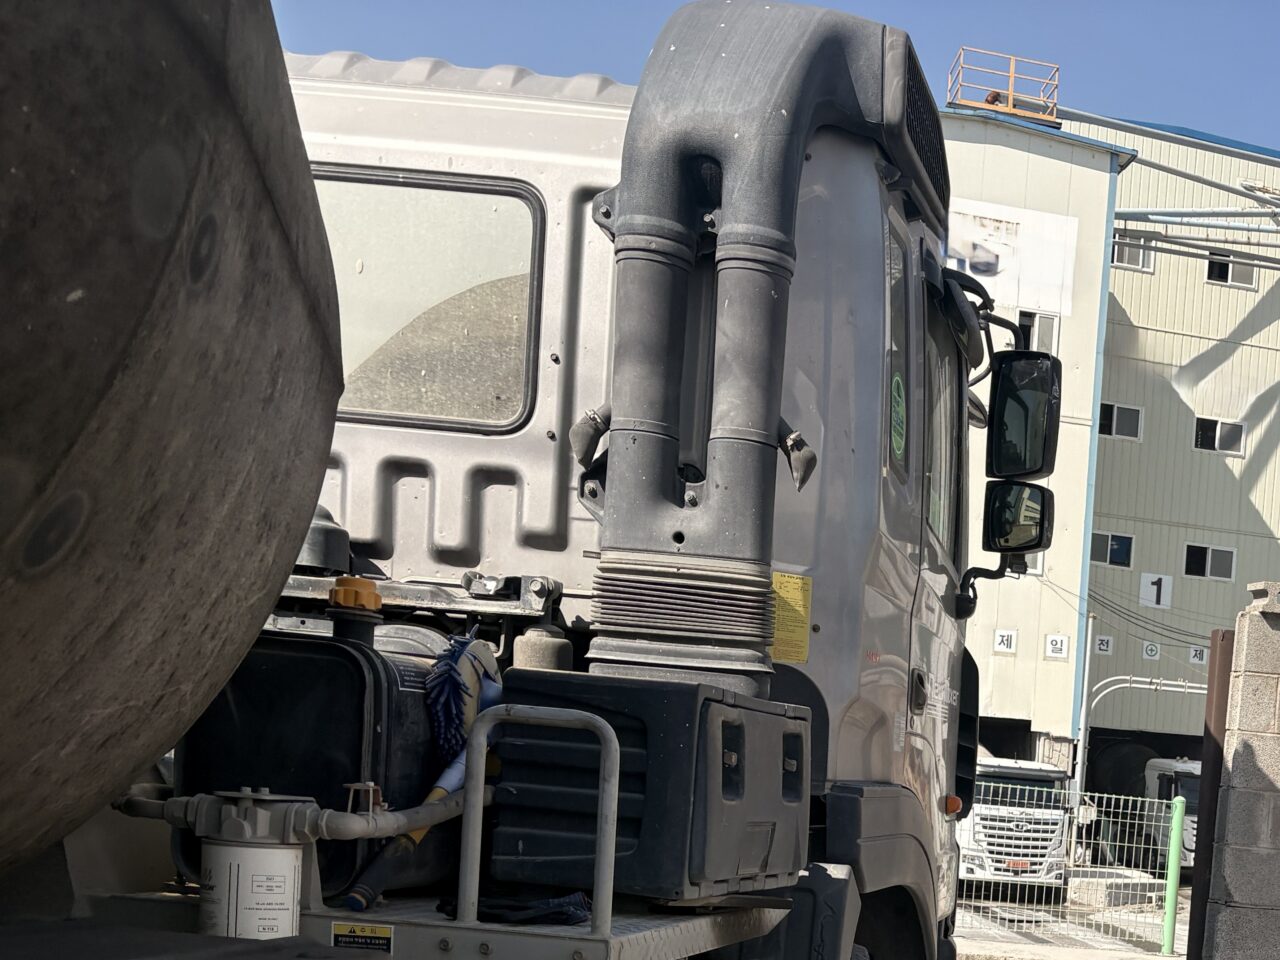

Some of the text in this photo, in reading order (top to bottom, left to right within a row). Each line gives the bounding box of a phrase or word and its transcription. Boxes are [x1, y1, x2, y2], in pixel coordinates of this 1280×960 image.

[1151, 577, 1163, 606] 1
[998, 634, 1063, 654] 제 일
[1098, 638, 1110, 652] 전
